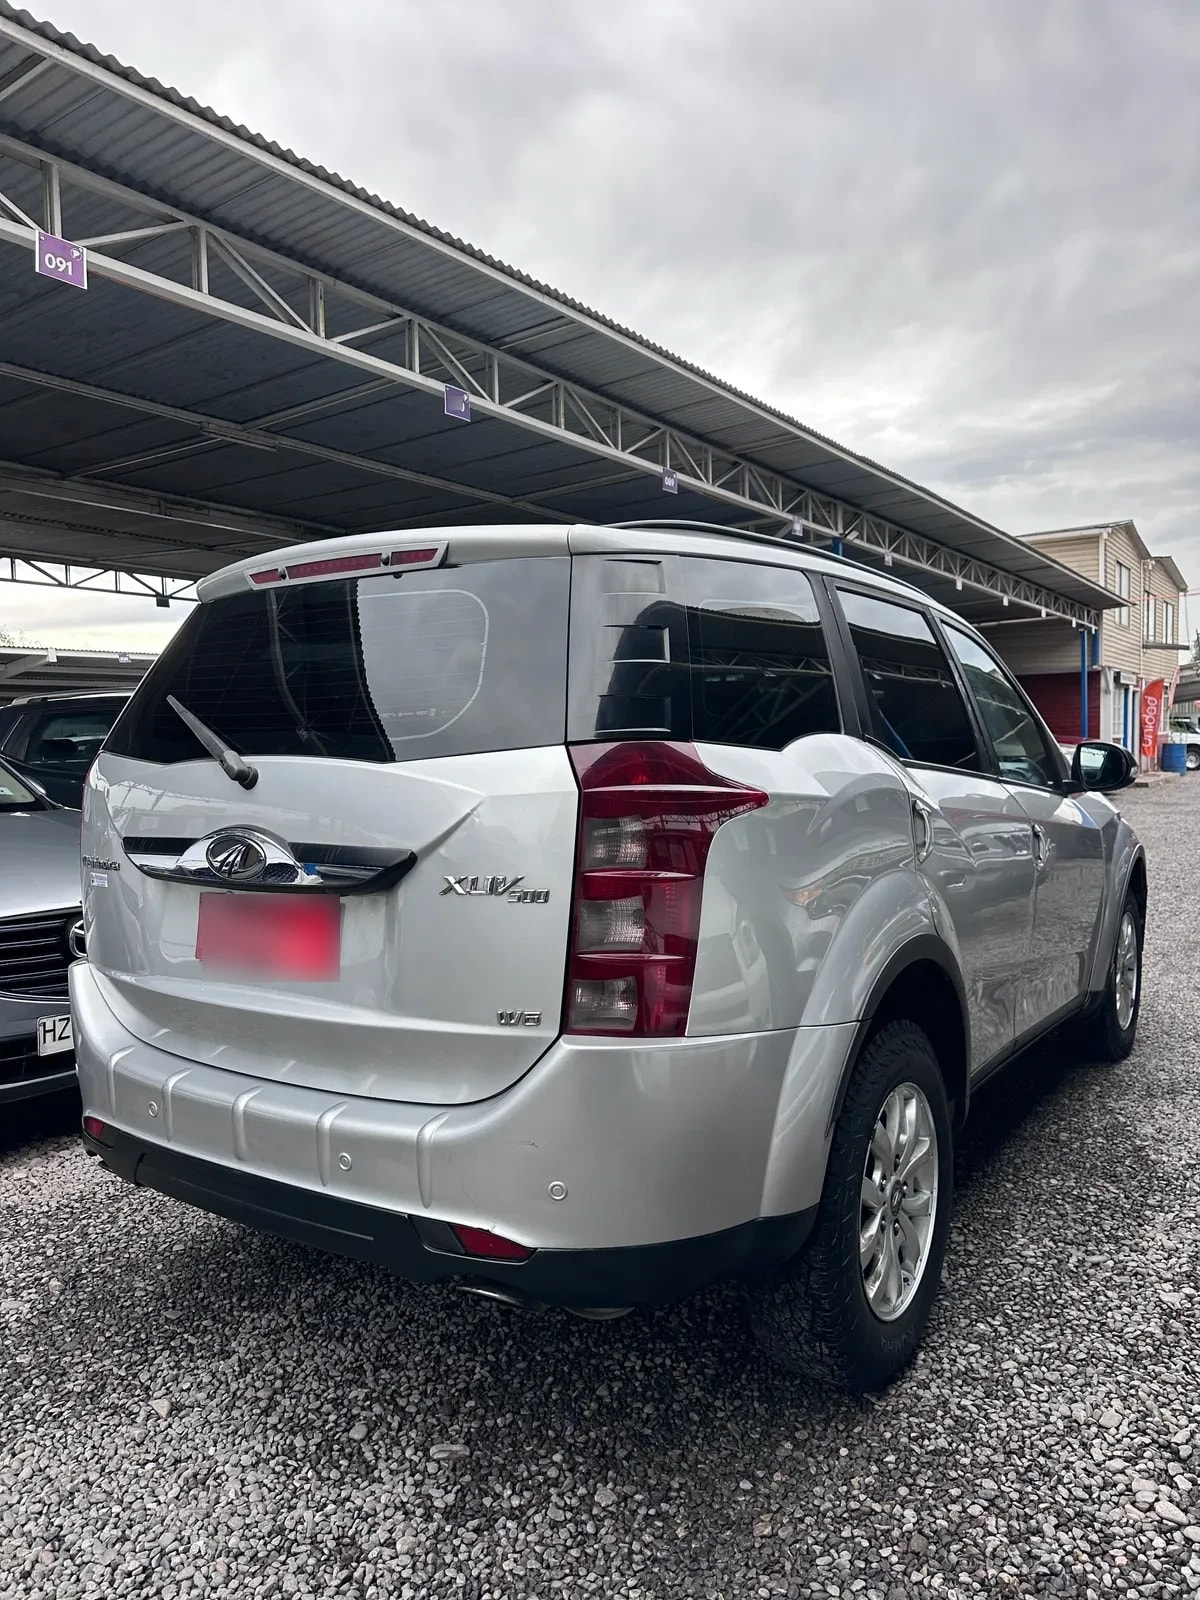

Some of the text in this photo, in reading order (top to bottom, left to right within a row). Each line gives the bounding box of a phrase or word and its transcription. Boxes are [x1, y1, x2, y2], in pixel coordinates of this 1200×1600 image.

[44, 253, 73, 276] 091
[1142, 695, 1158, 748] unidad
[496, 1010, 542, 1027] W6
